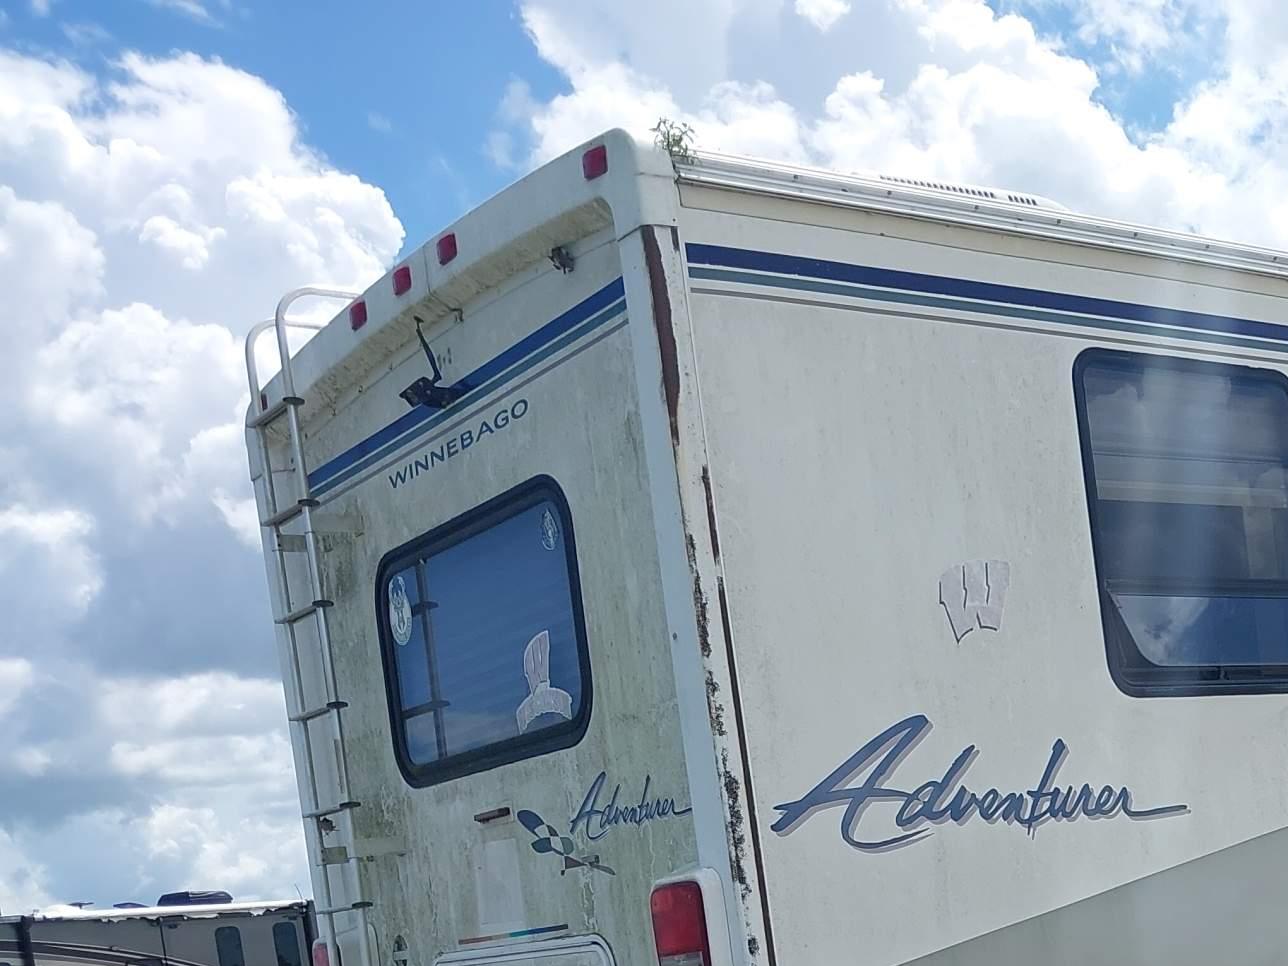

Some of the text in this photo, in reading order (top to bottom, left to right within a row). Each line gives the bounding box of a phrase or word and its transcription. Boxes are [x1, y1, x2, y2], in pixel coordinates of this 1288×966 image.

[388, 398, 530, 489] WINNEBAGO
[569, 770, 693, 841] Adventurer
[770, 713, 1191, 855] Adventurer
